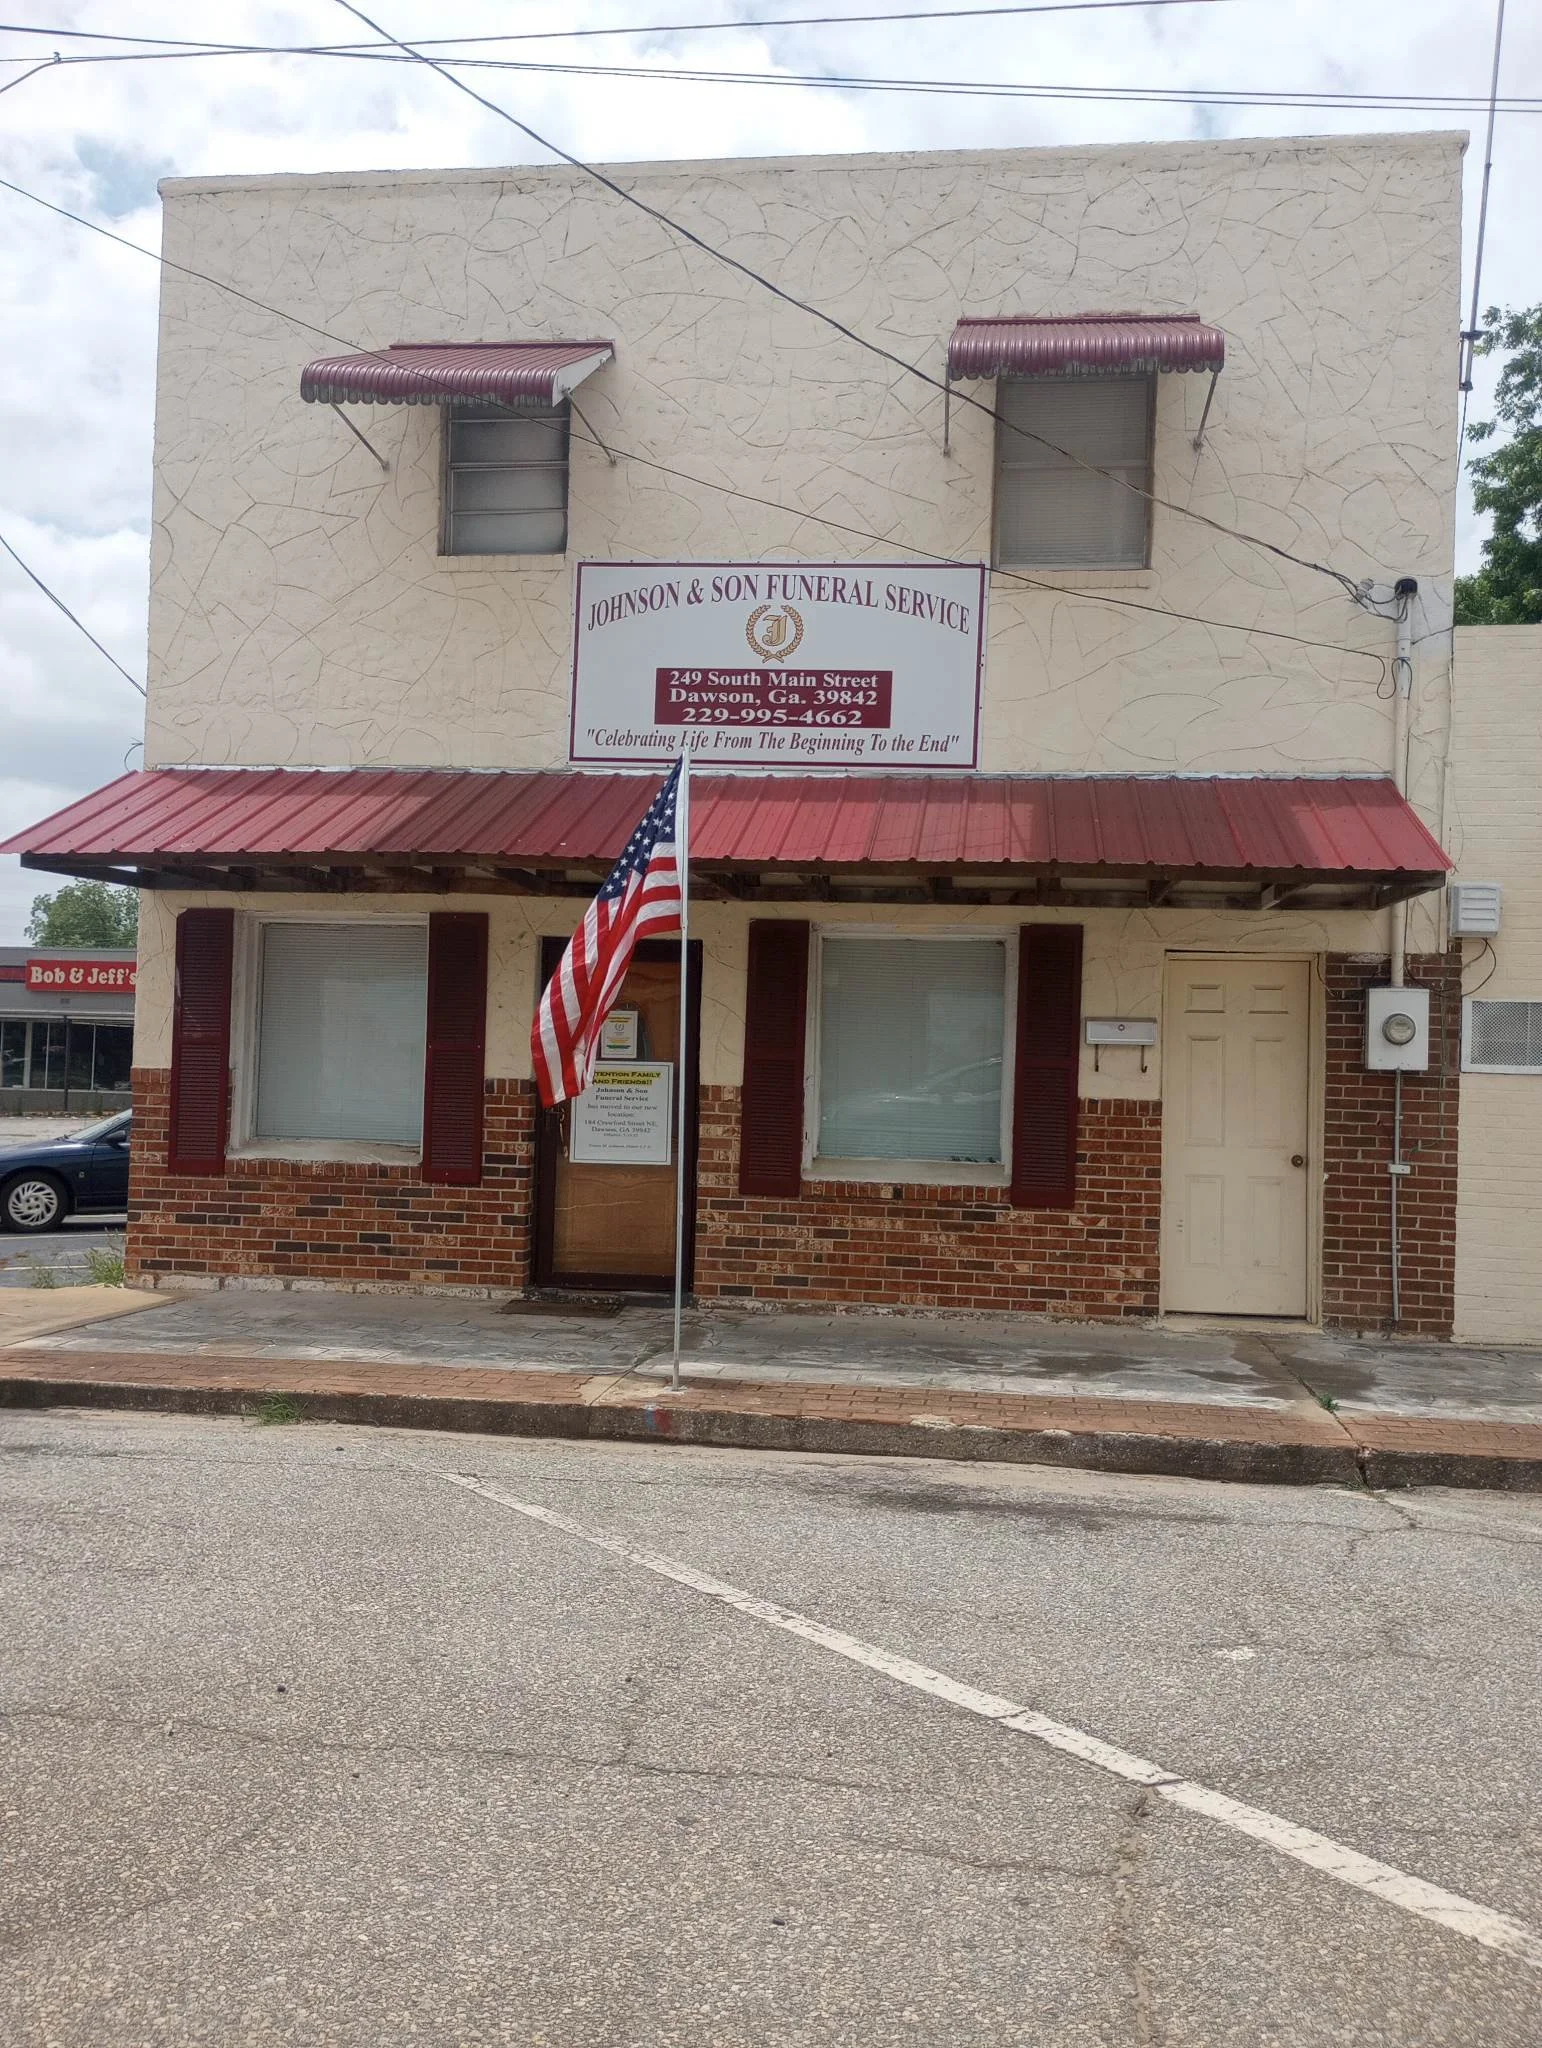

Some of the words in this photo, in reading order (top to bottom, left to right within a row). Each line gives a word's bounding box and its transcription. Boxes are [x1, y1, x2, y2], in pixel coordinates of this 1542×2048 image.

[588, 581, 680, 631] JOHNSON
[687, 578, 704, 605] &
[711, 574, 759, 603] SON
[766, 574, 879, 608] FUNERAL
[885, 583, 970, 635] SERVICE
[670, 671, 702, 686] 249
[708, 671, 761, 687] South
[768, 672, 817, 687] Main
[823, 672, 879, 688] Street
[669, 688, 761, 706] Dawson,
[768, 689, 806, 705] Ga.
[813, 690, 877, 706] 39842
[683, 707, 863, 725] 229-995-4662
[587, 729, 676, 752] "Celebrating
[680, 730, 709, 752] Life
[713, 731, 752, 748] From
[759, 732, 784, 749] The
[790, 732, 865, 756] Beginning
[871, 733, 886, 751] To
[891, 734, 913, 752] the
[918, 734, 960, 753] End"
[30, 966, 65, 984] Bob
[69, 967, 84, 984] &
[87, 967, 137, 985] Jeff's
